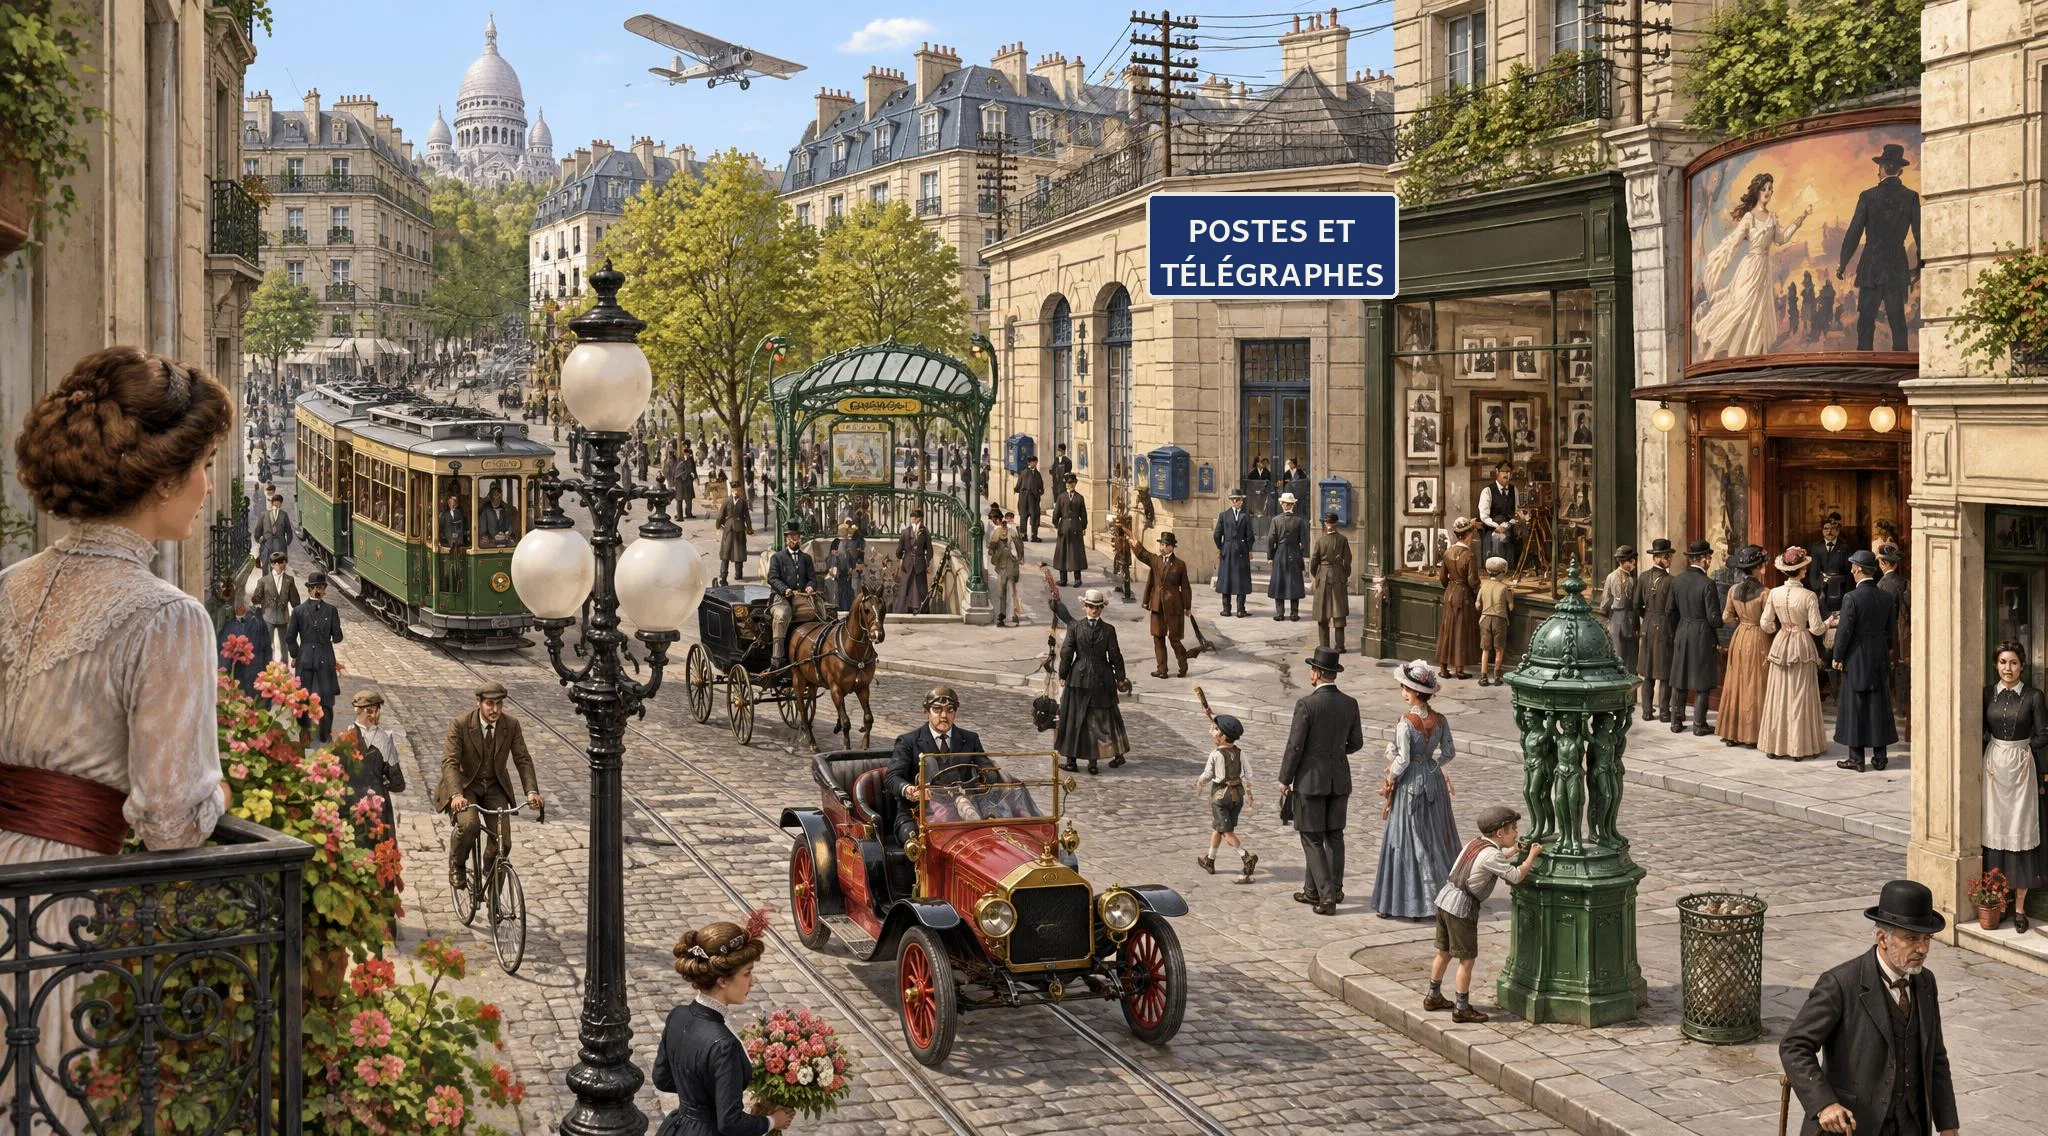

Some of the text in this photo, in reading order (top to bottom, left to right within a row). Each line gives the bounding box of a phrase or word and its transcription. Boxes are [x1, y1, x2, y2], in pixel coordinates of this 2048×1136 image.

[1189, 219, 1356, 243] POSTES ET
[1160, 254, 1384, 287] TÉLÉGRAPHES
